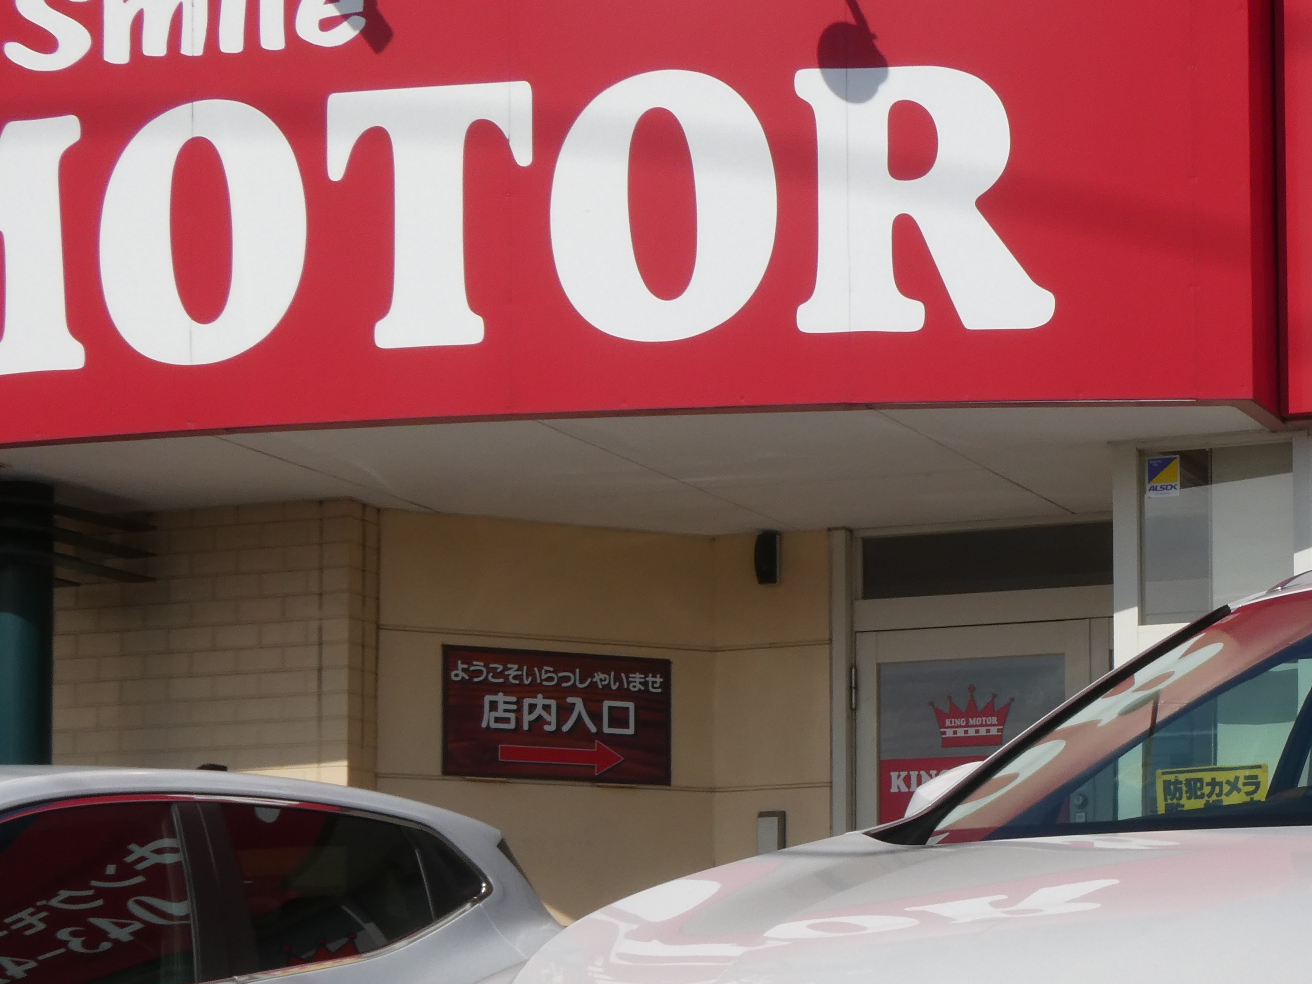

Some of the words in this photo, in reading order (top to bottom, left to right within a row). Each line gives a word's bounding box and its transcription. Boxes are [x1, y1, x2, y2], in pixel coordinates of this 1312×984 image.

[481, 692, 635, 735] 店内入口
[945, 717, 967, 727] KING
[968, 716, 999, 726] MOTOR
[890, 769, 951, 793] KIN
[1162, 774, 1262, 801] 防犯カメラ
